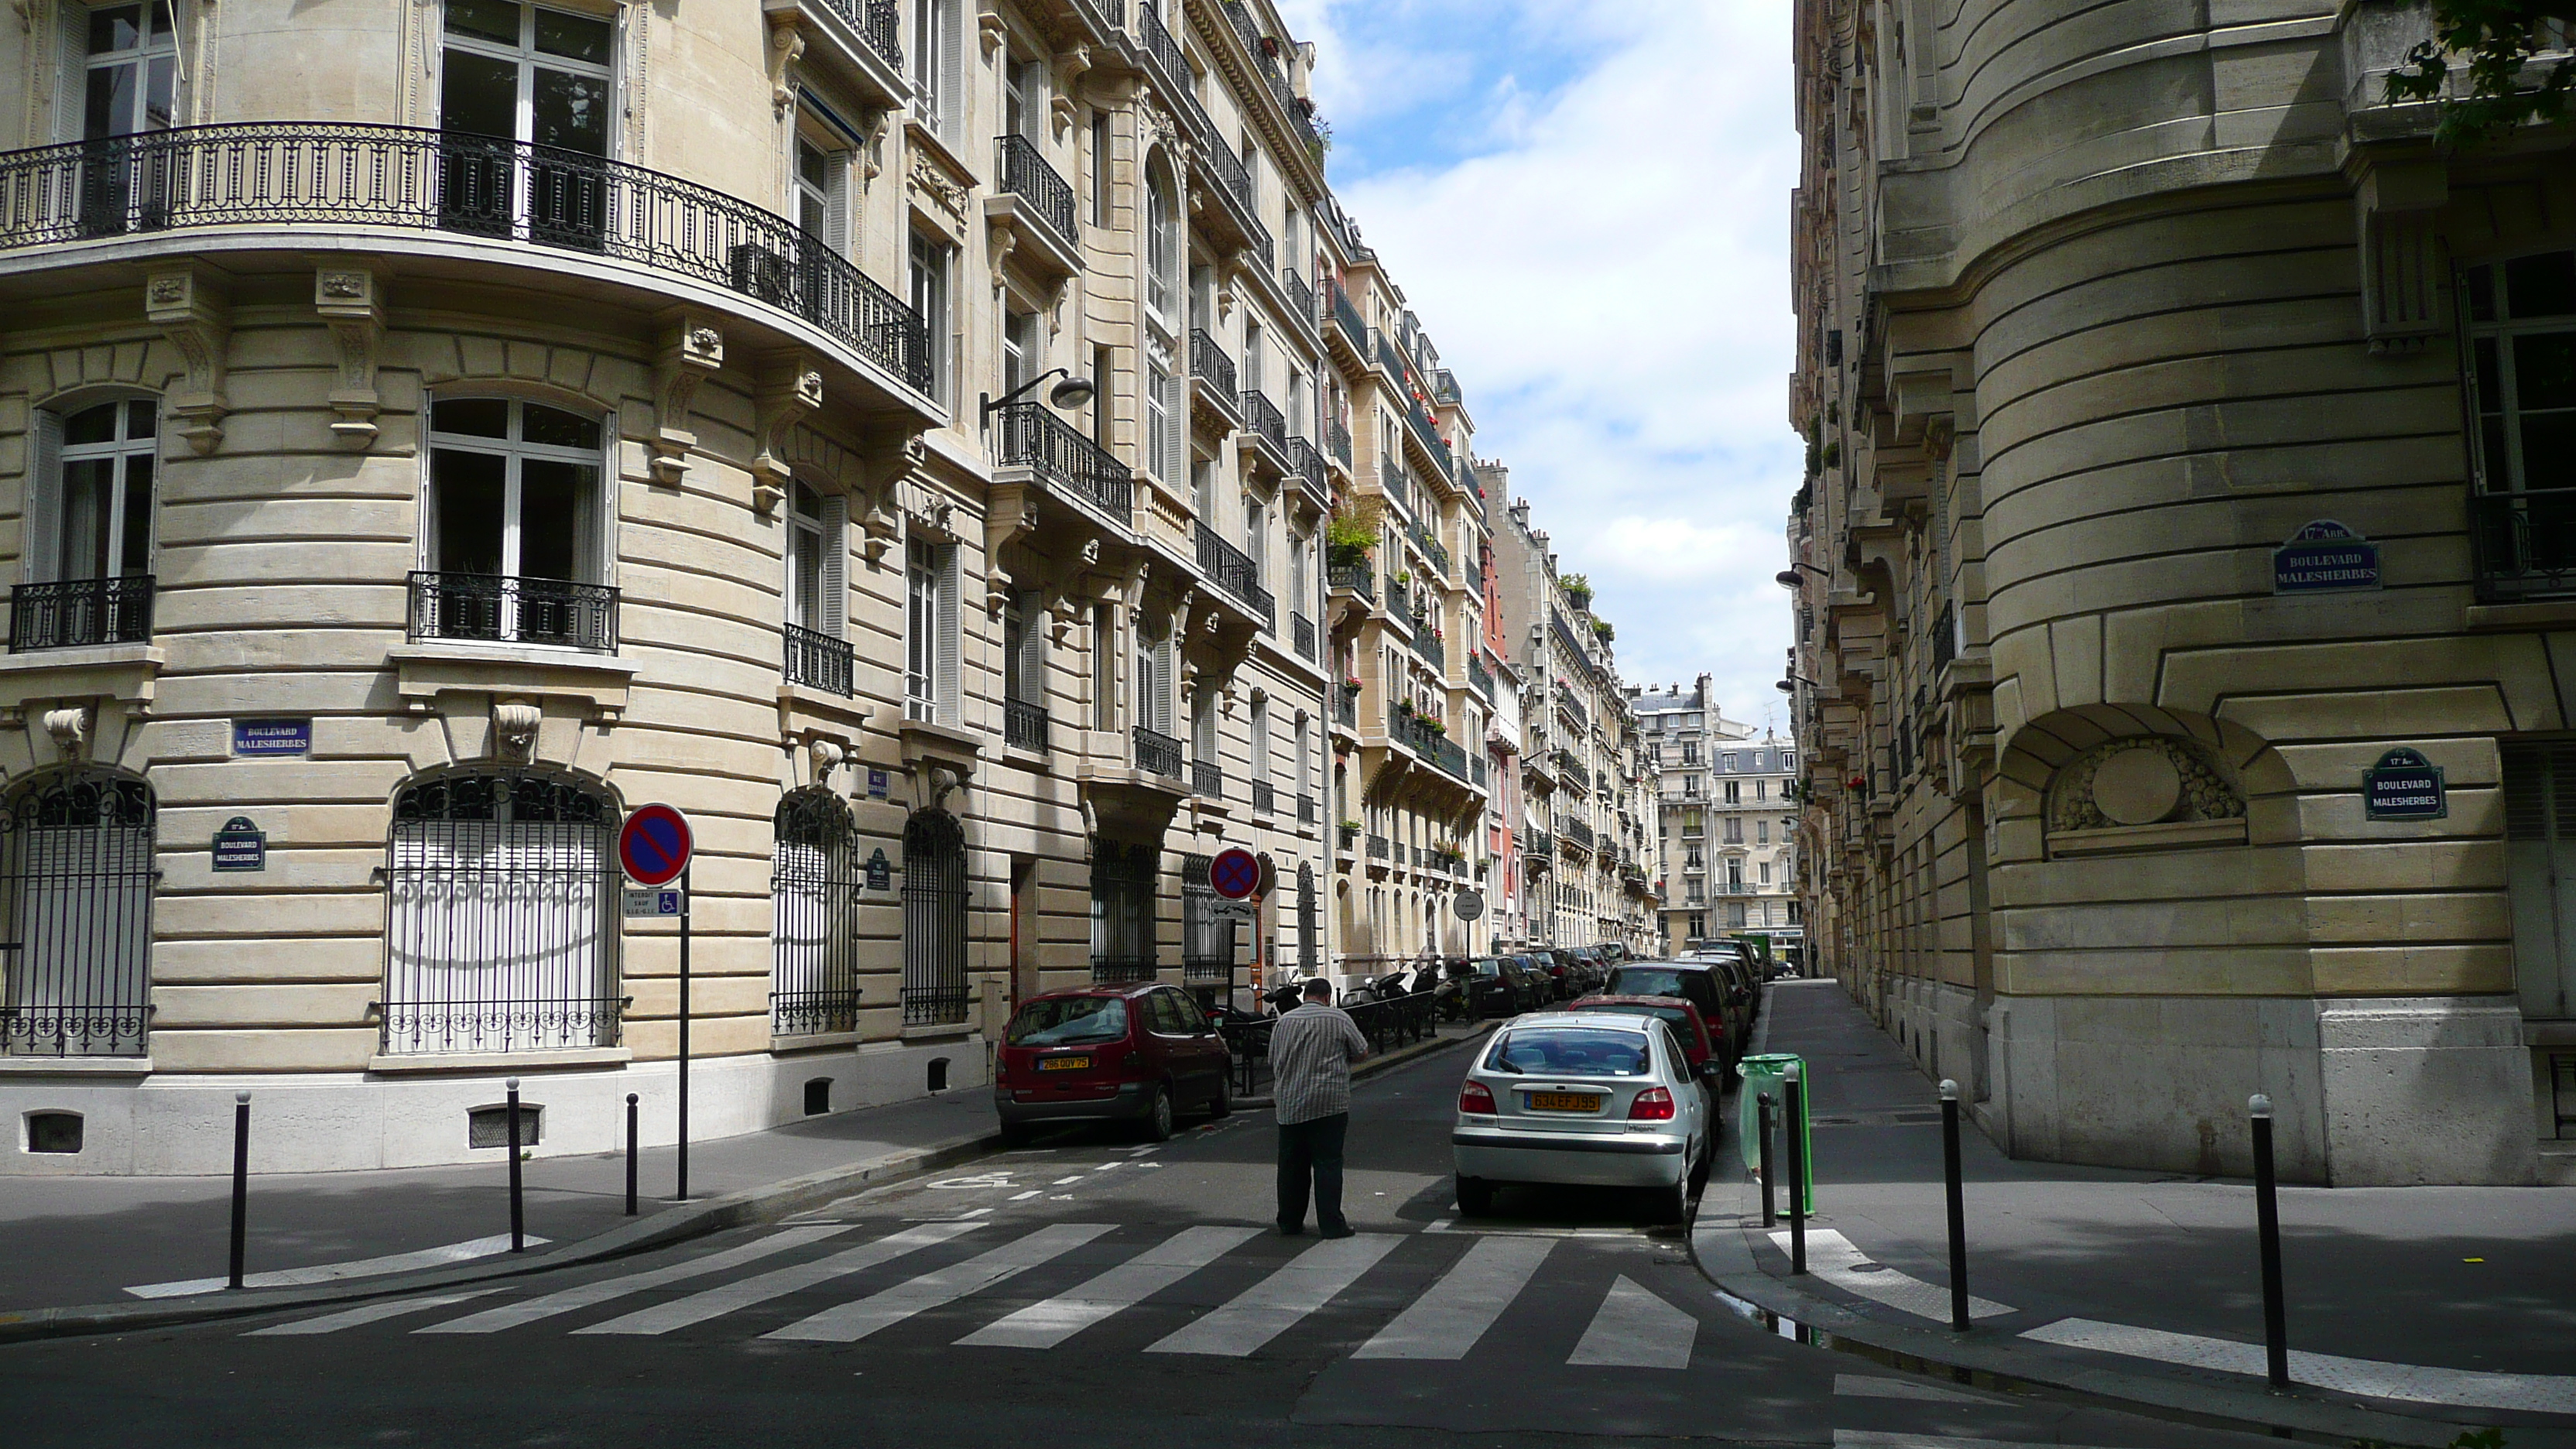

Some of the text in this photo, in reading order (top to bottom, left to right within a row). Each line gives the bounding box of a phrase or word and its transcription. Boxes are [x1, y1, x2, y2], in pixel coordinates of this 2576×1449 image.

[2290, 553, 2362, 568] BOULEVARD
[2277, 568, 2377, 584] MALESHERBES
[248, 728, 297, 736] BOULEVARD
[236, 738, 307, 748] MALESHERBES
[2377, 779, 2432, 791] BOULEVARD
[2373, 796, 2437, 807] MALESHERBES
[1535, 1094, 1596, 1108] 634 EFJ 95
